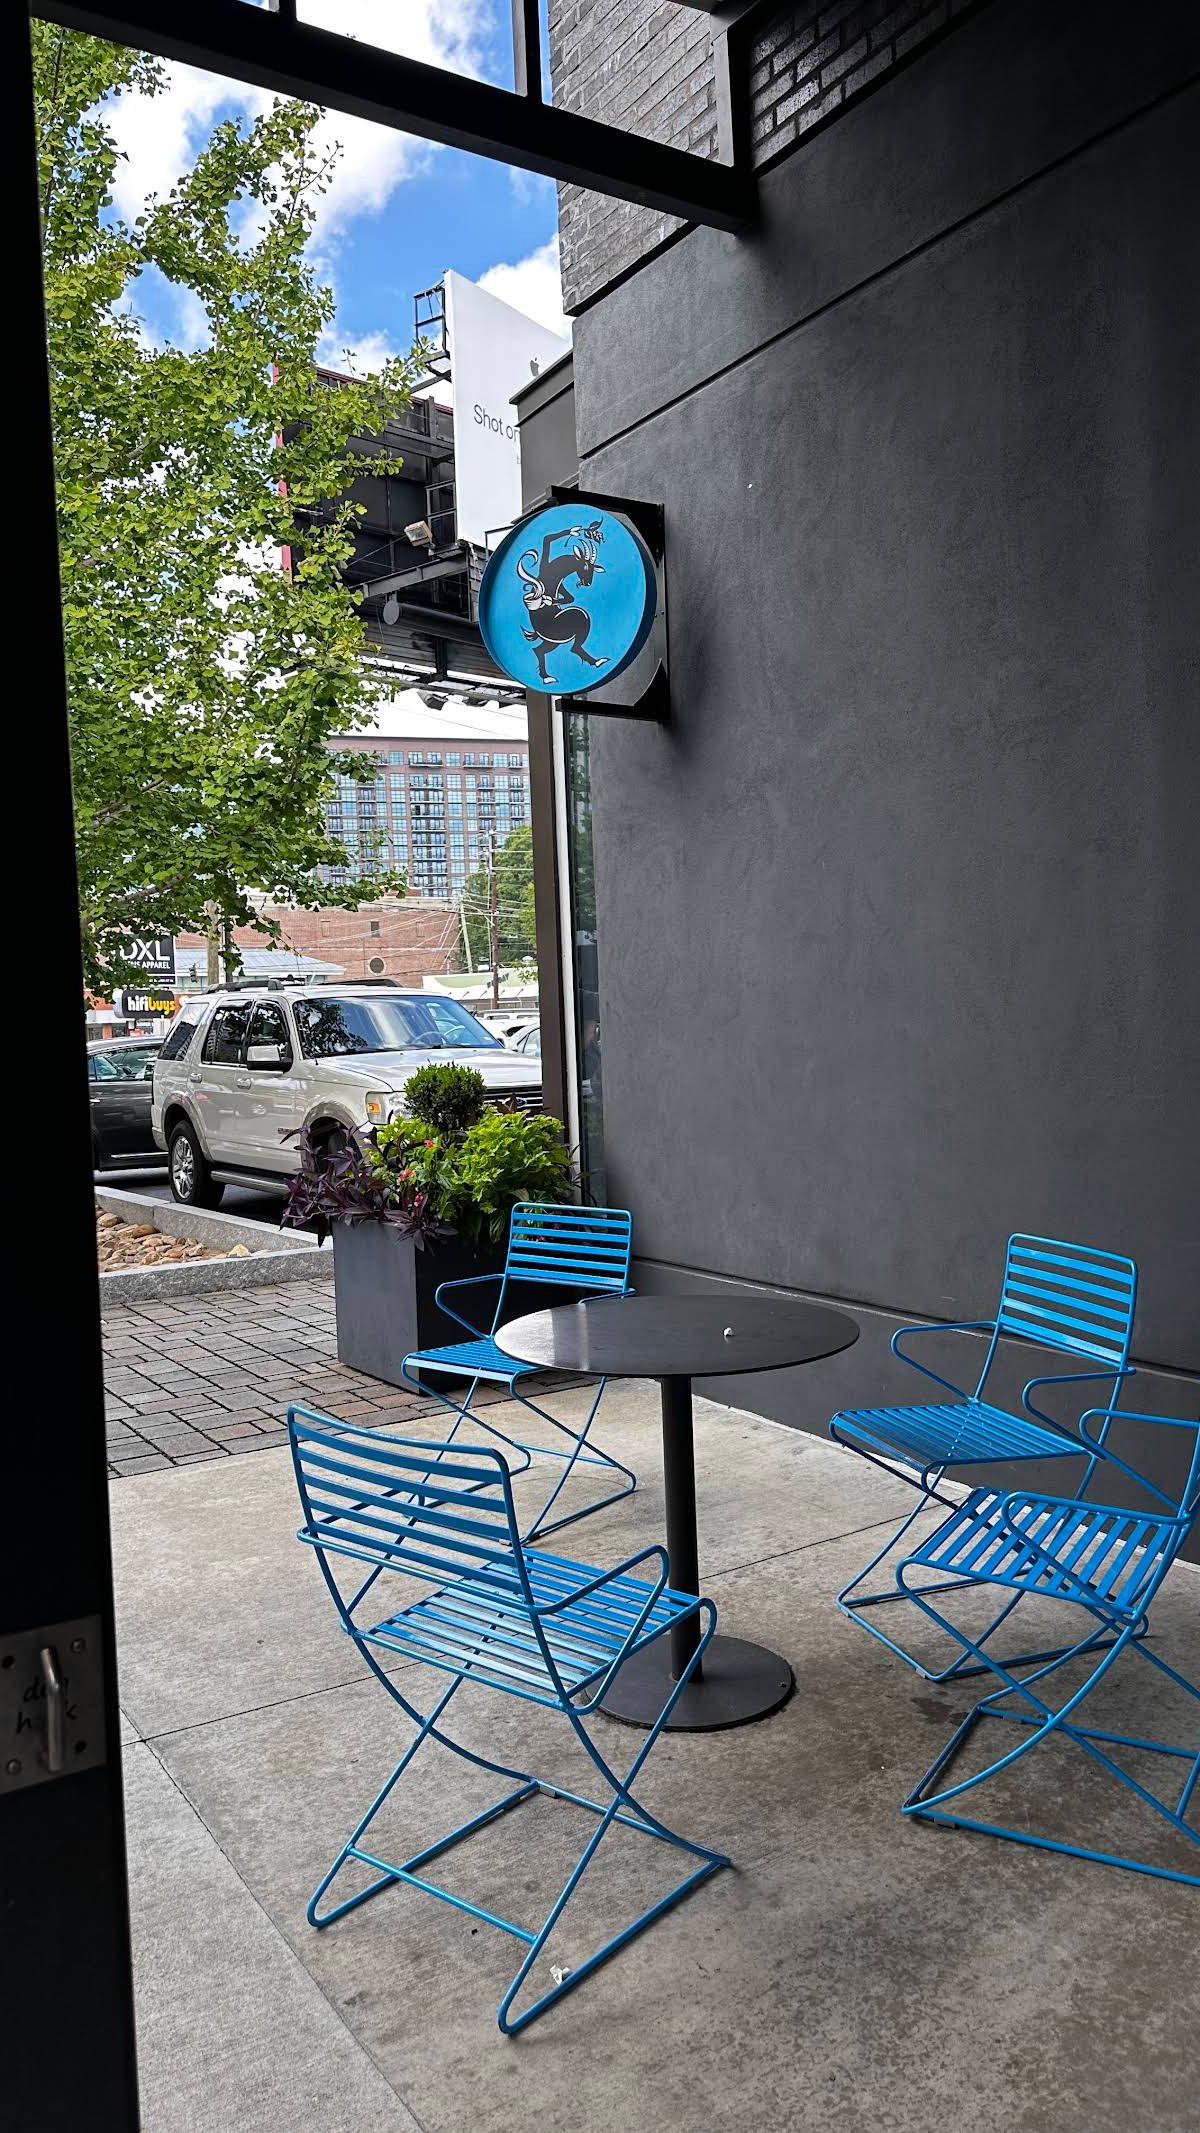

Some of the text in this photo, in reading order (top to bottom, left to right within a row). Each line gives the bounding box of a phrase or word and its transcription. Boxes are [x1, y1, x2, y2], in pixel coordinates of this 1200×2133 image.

[474, 404, 504, 436] Shot
[141, 960, 171, 969] APPAREL
[127, 995, 176, 1015] hifibuys
